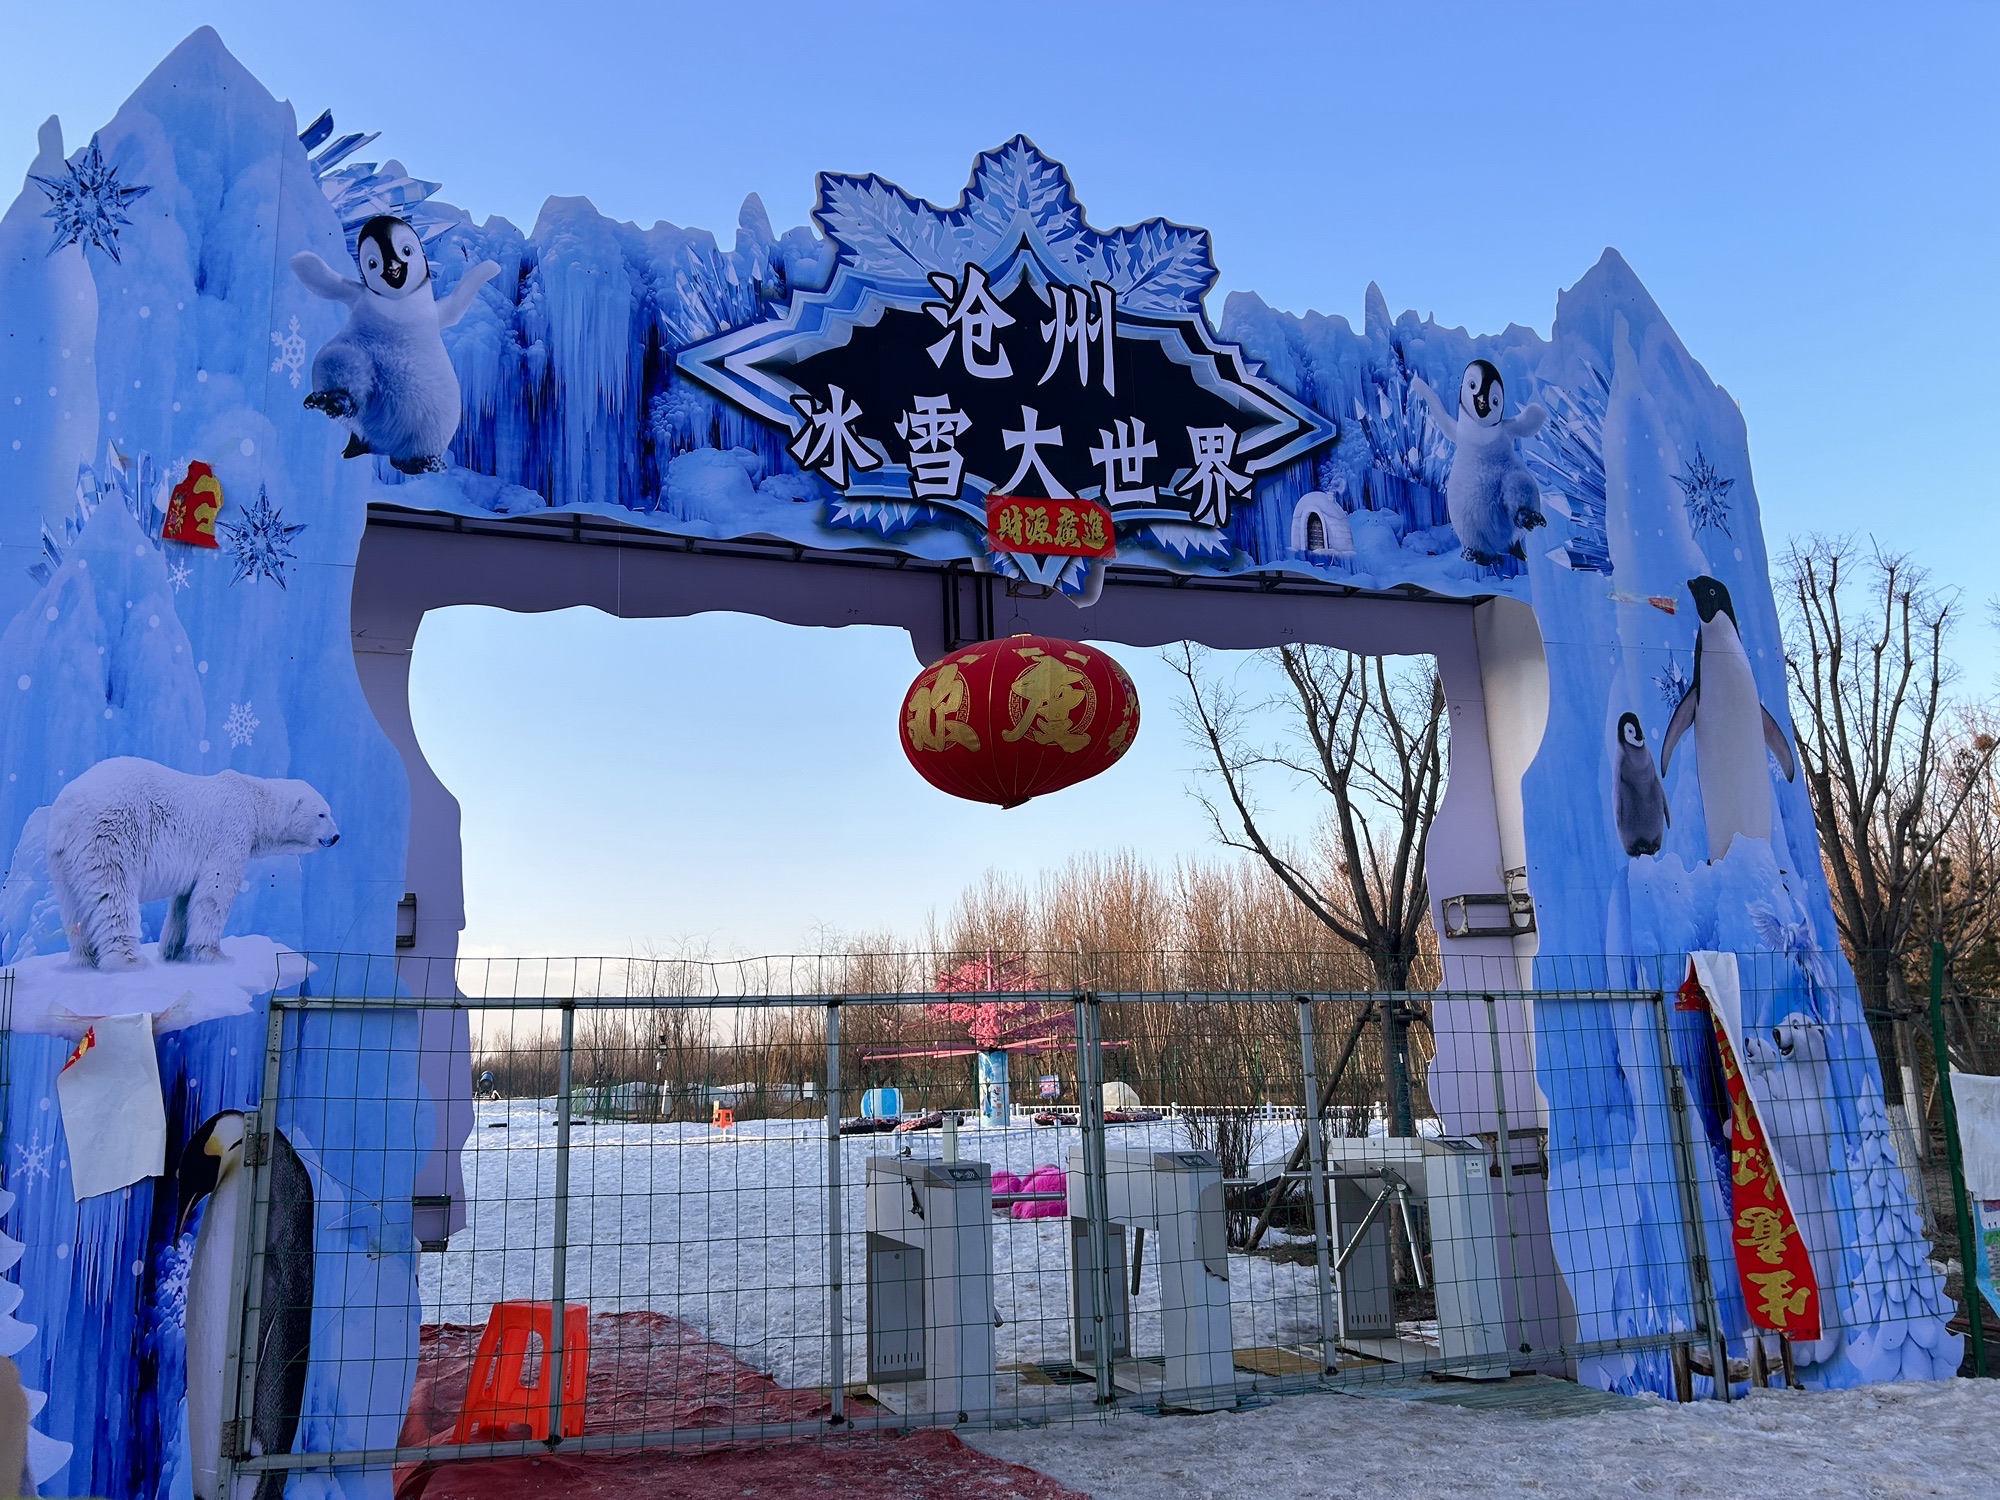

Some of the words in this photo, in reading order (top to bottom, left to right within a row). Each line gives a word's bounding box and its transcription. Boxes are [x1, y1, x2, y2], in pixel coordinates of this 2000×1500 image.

[926, 263, 1116, 397] 沧州
[790, 384, 1254, 526] 冰雪大世界
[996, 504, 1109, 550] 財源廣進
